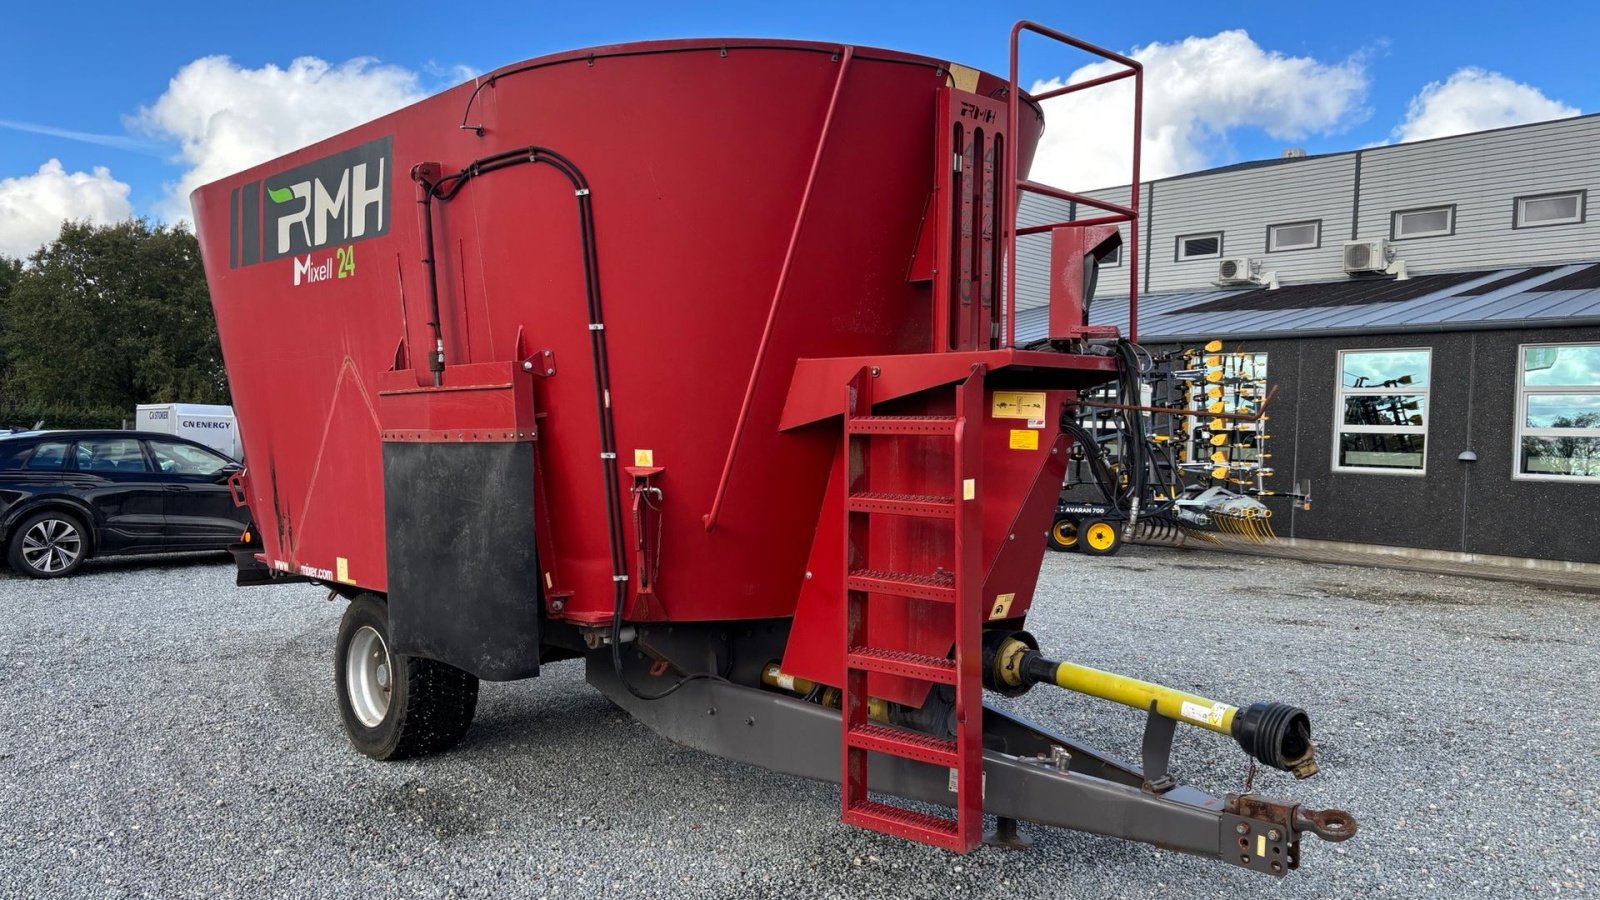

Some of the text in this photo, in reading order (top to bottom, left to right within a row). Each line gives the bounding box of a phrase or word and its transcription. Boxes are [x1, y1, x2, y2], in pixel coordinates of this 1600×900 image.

[267, 157, 384, 254] RMH
[294, 245, 355, 286] Mixell 24
[196, 421, 231, 429] ENERGY
